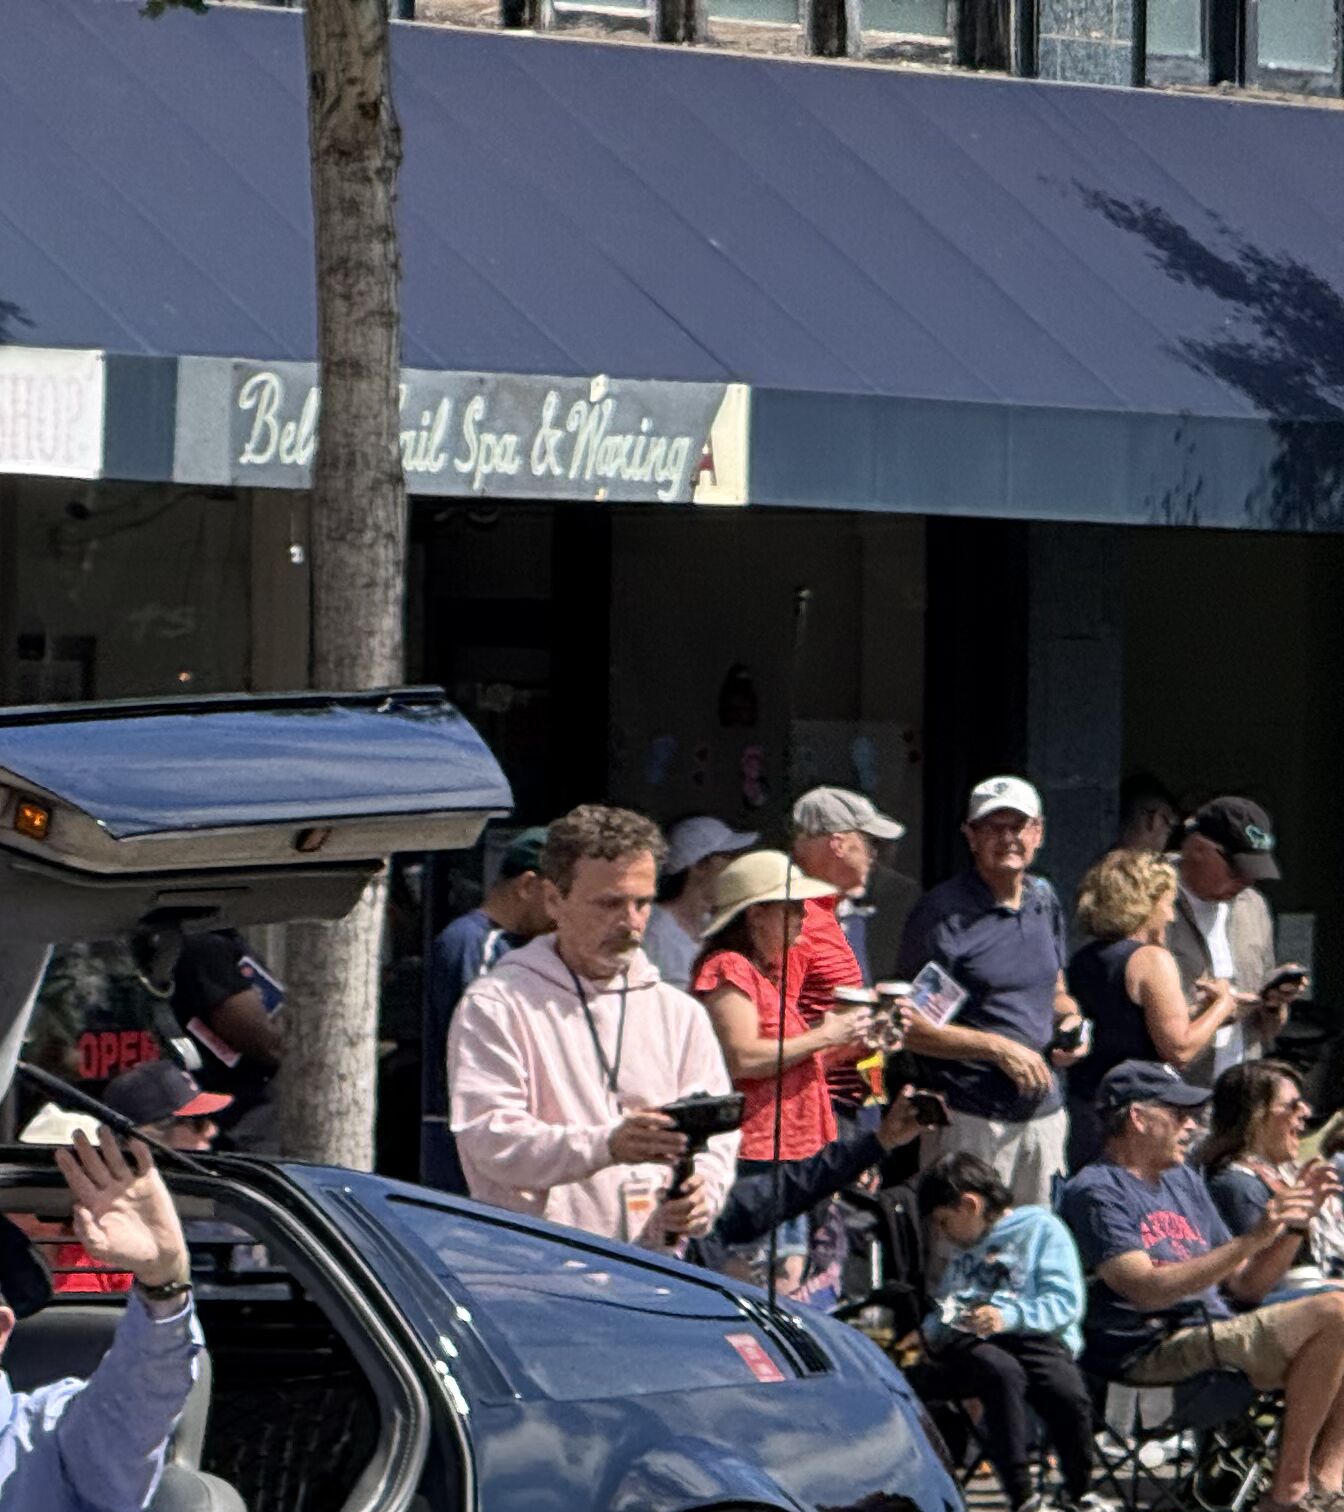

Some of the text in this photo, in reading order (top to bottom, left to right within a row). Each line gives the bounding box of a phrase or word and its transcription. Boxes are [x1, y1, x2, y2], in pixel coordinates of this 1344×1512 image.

[399, 384, 451, 474] ail
[454, 396, 522, 490] Spa
[530, 390, 563, 477] &
[566, 396, 693, 503] Waxing
[78, 1029, 161, 1079] OPEN
